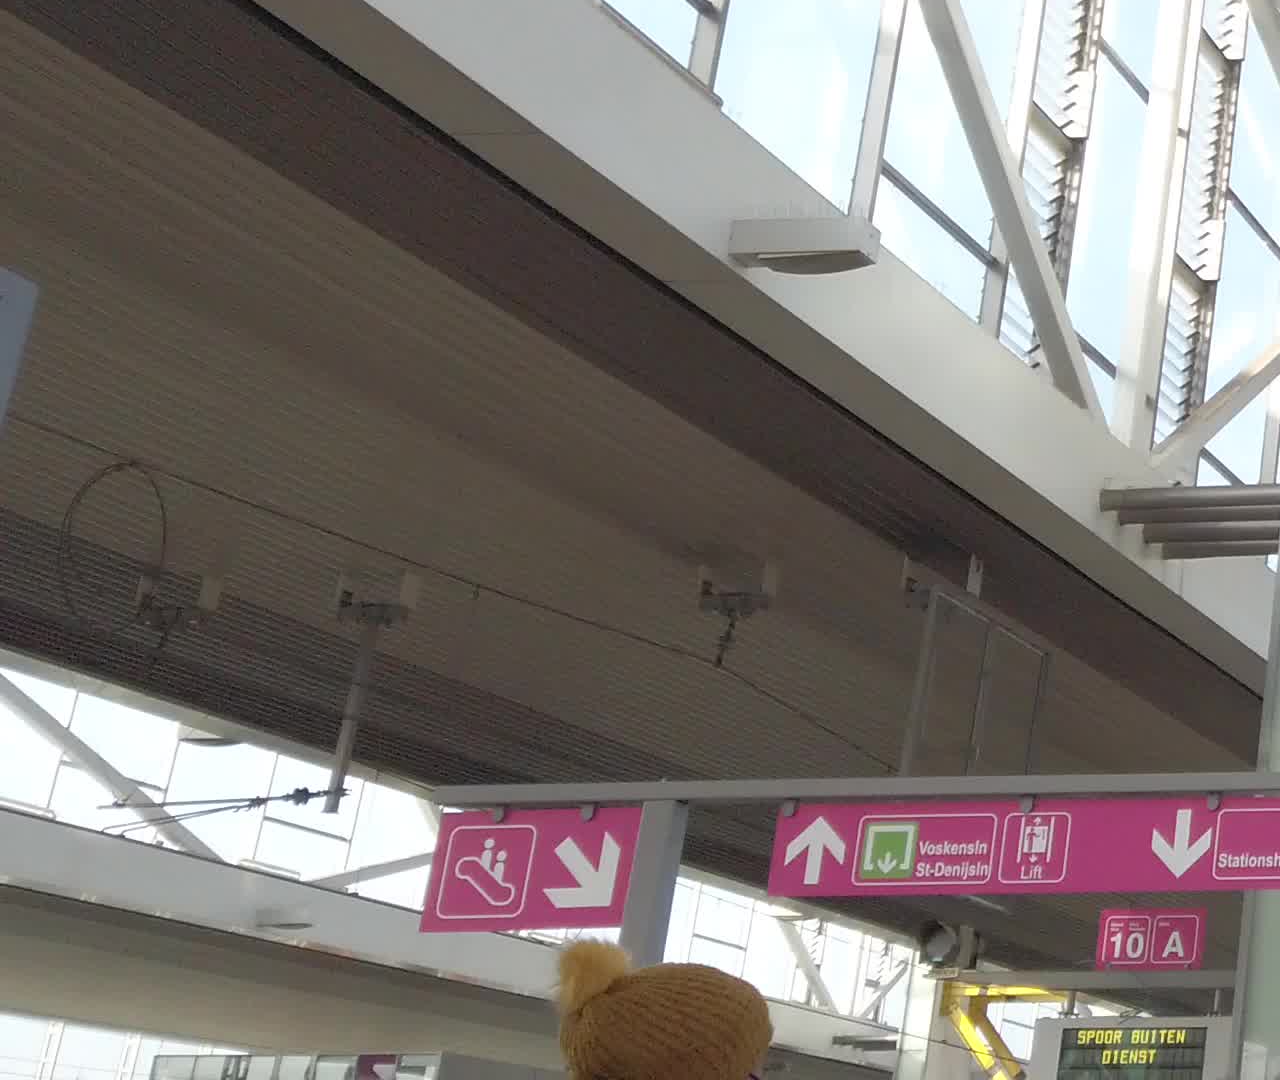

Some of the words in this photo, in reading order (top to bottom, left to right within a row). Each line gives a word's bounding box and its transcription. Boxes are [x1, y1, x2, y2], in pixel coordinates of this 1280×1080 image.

[1020, 866, 1043, 880] Lift
[1110, 931, 1145, 959] 10
[1161, 930, 1185, 958] A
[1077, 1029, 1123, 1045] SPOOR
[1131, 1029, 1186, 1044] BUITEN
[1101, 1049, 1157, 1065] DIENST
